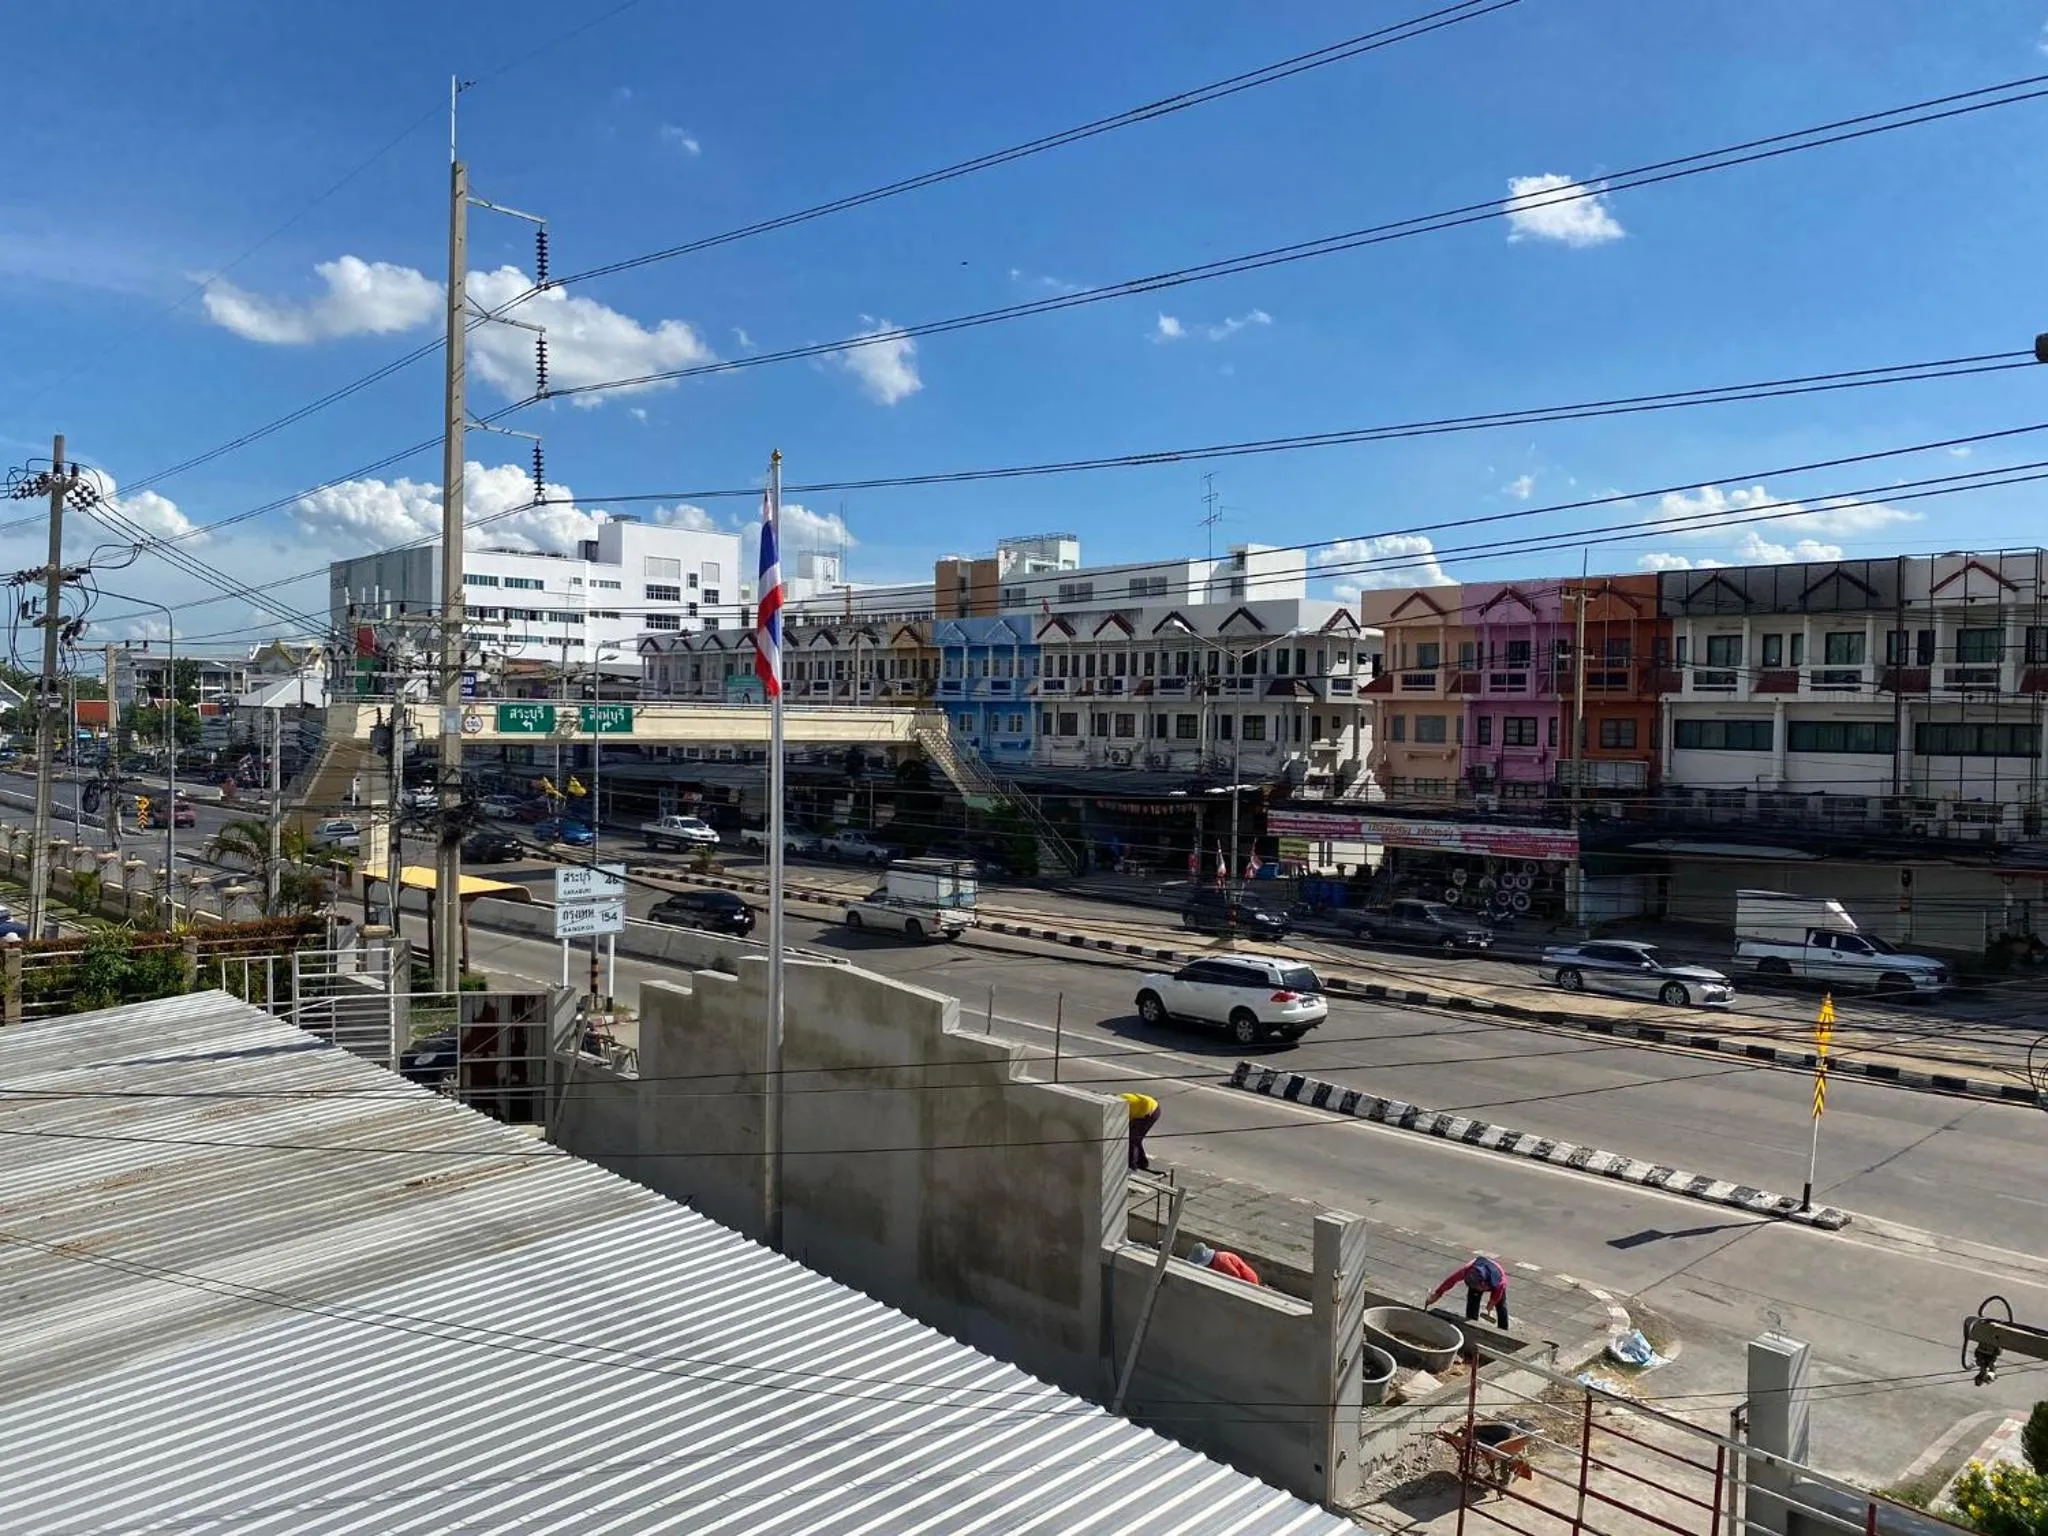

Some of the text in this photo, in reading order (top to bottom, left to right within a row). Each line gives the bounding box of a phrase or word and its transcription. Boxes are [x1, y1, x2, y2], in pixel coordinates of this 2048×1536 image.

[510, 706, 544, 723] สระบุรี
[602, 911, 618, 923] 154
